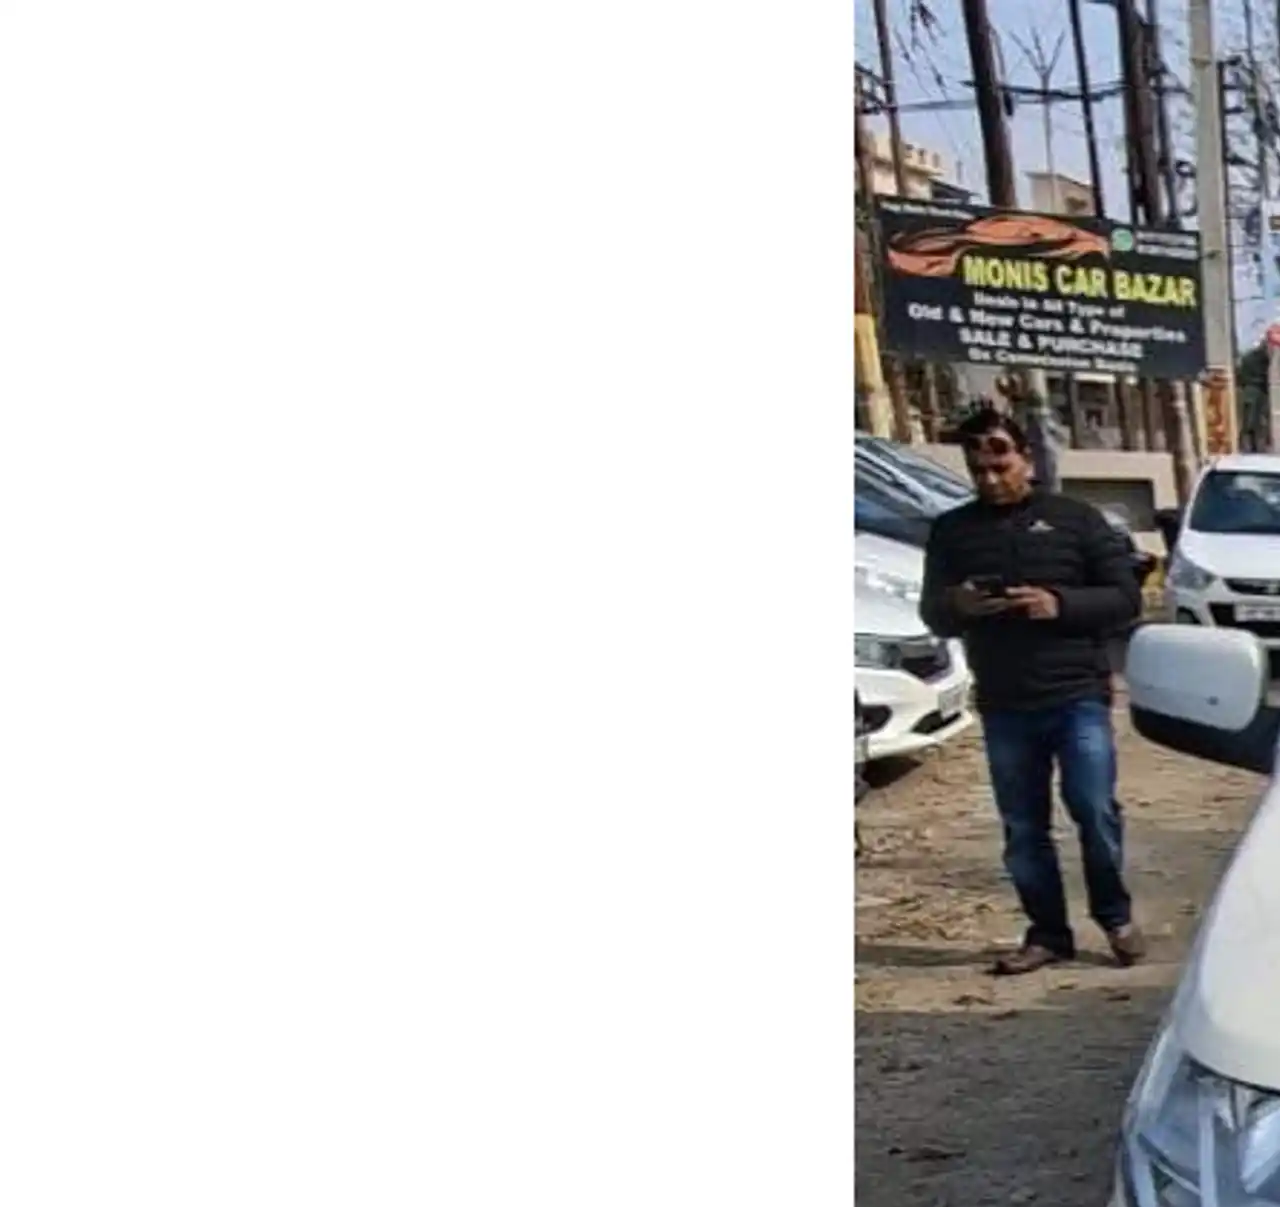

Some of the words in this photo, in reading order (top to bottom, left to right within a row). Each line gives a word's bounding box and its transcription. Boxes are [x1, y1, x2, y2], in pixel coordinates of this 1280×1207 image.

[963, 255, 1048, 292] MONIS
[1055, 264, 1108, 298] CAR
[1114, 270, 1196, 307] BAZAR
[908, 302, 944, 320] Old
[949, 305, 964, 323] &
[969, 308, 1014, 326] New
[1019, 314, 1064, 332] Cars
[1090, 319, 1187, 343] Properties
[959, 327, 1012, 346] SALE
[1017, 333, 1033, 349] &
[1038, 335, 1143, 358] PURCHASE
